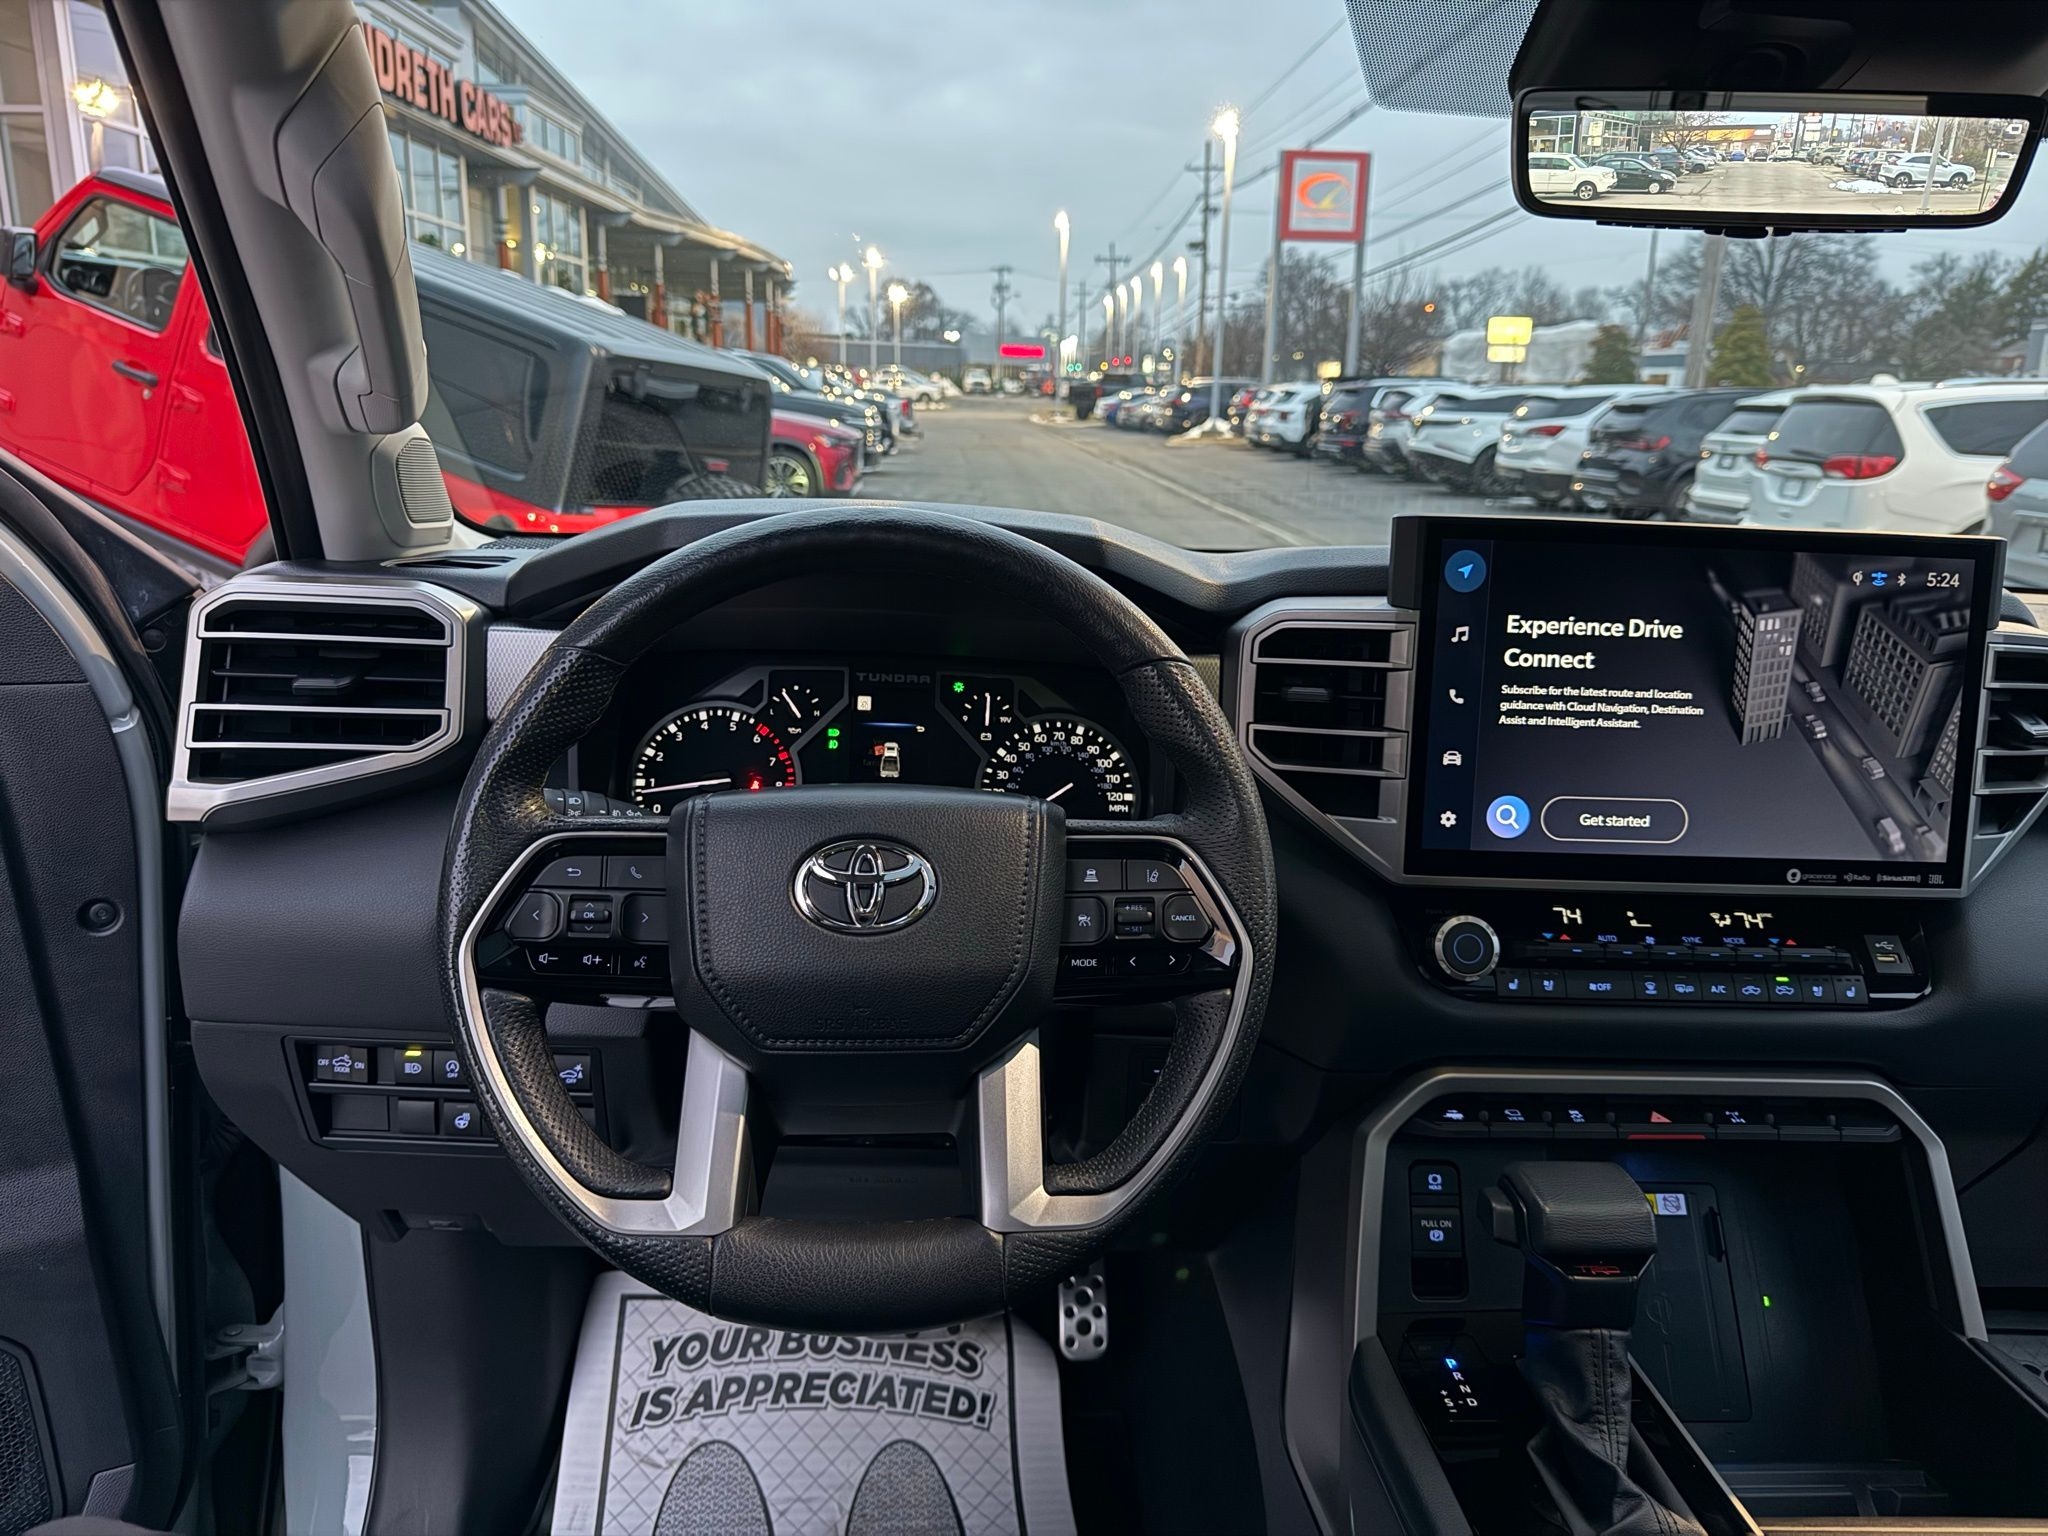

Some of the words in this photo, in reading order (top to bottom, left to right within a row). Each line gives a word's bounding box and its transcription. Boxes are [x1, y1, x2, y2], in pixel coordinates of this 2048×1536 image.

[460, 79, 513, 149] CARS
[1926, 572, 1960, 588] 5:24
[1506, 614, 1625, 640] Experience
[1628, 618, 1684, 640] Drive
[1504, 648, 1596, 670] Connect
[856, 672, 931, 684] TUNDRA
[1501, 684, 1548, 696] Subscribe
[1548, 685, 1563, 697] for
[1563, 686, 1580, 697] the
[1580, 687, 1608, 698] latest
[1608, 689, 1634, 699] route
[1634, 689, 1654, 699] and
[1654, 689, 1693, 700] location
[1499, 700, 1545, 712] guidance
[1545, 701, 1566, 711] with
[1566, 701, 1596, 712] Cloud
[1597, 702, 1650, 715] Navigation,
[1650, 704, 1704, 716] Destination
[813, 709, 820, 717] H
[700, 722, 709, 731] 4
[729, 722, 737, 731] 5
[1498, 715, 1527, 726] Assist
[1527, 715, 1547, 726] and
[1547, 716, 1595, 729] Intelligent
[1595, 717, 1642, 729] Assistant.
[676, 731, 683, 741] 3
[753, 734, 761, 743] 6
[1034, 734, 1047, 743] 60
[1053, 731, 1065, 741] 70
[1070, 735, 1083, 745] 80
[1018, 742, 1031, 751] 50
[1087, 745, 1100, 755] 90
[655, 752, 664, 762] 2
[1003, 754, 1017, 763] 40
[769, 757, 776, 767] 7
[1096, 758, 1113, 768] 100
[996, 771, 1009, 780] 30
[1105, 774, 1120, 783] 110
[649, 778, 654, 787] 1
[1106, 792, 1123, 801] 120
[653, 804, 661, 813] 0
[1108, 804, 1129, 812] MPH
[1580, 813, 1604, 826] Get
[1605, 814, 1651, 828] started
[1928, 874, 1945, 885] JBL
[583, 911, 595, 919] OK
[1552, 907, 1583, 924] 74
[1733, 911, 1764, 929] 74
[1597, 935, 1618, 943] AUTO
[1681, 936, 1703, 944] SYNC
[1723, 937, 1746, 945] MODE
[1071, 958, 1098, 967] MODE
[1597, 982, 1612, 991] OFF
[1711, 985, 1727, 994] A/C
[1421, 1219, 1438, 1228] PULL
[1440, 1220, 1452, 1228] ON
[652, 1326, 769, 1373] YOUR
[777, 1332, 981, 1374] BUSINESS
[1445, 1358, 1457, 1369] P
[1452, 1371, 1464, 1381] R
[1459, 1384, 1472, 1393] N
[629, 1386, 677, 1428] IS
[679, 1371, 992, 1424] APPRECIATED!
[1444, 1398, 1454, 1407] S
[1466, 1398, 1478, 1407] D
